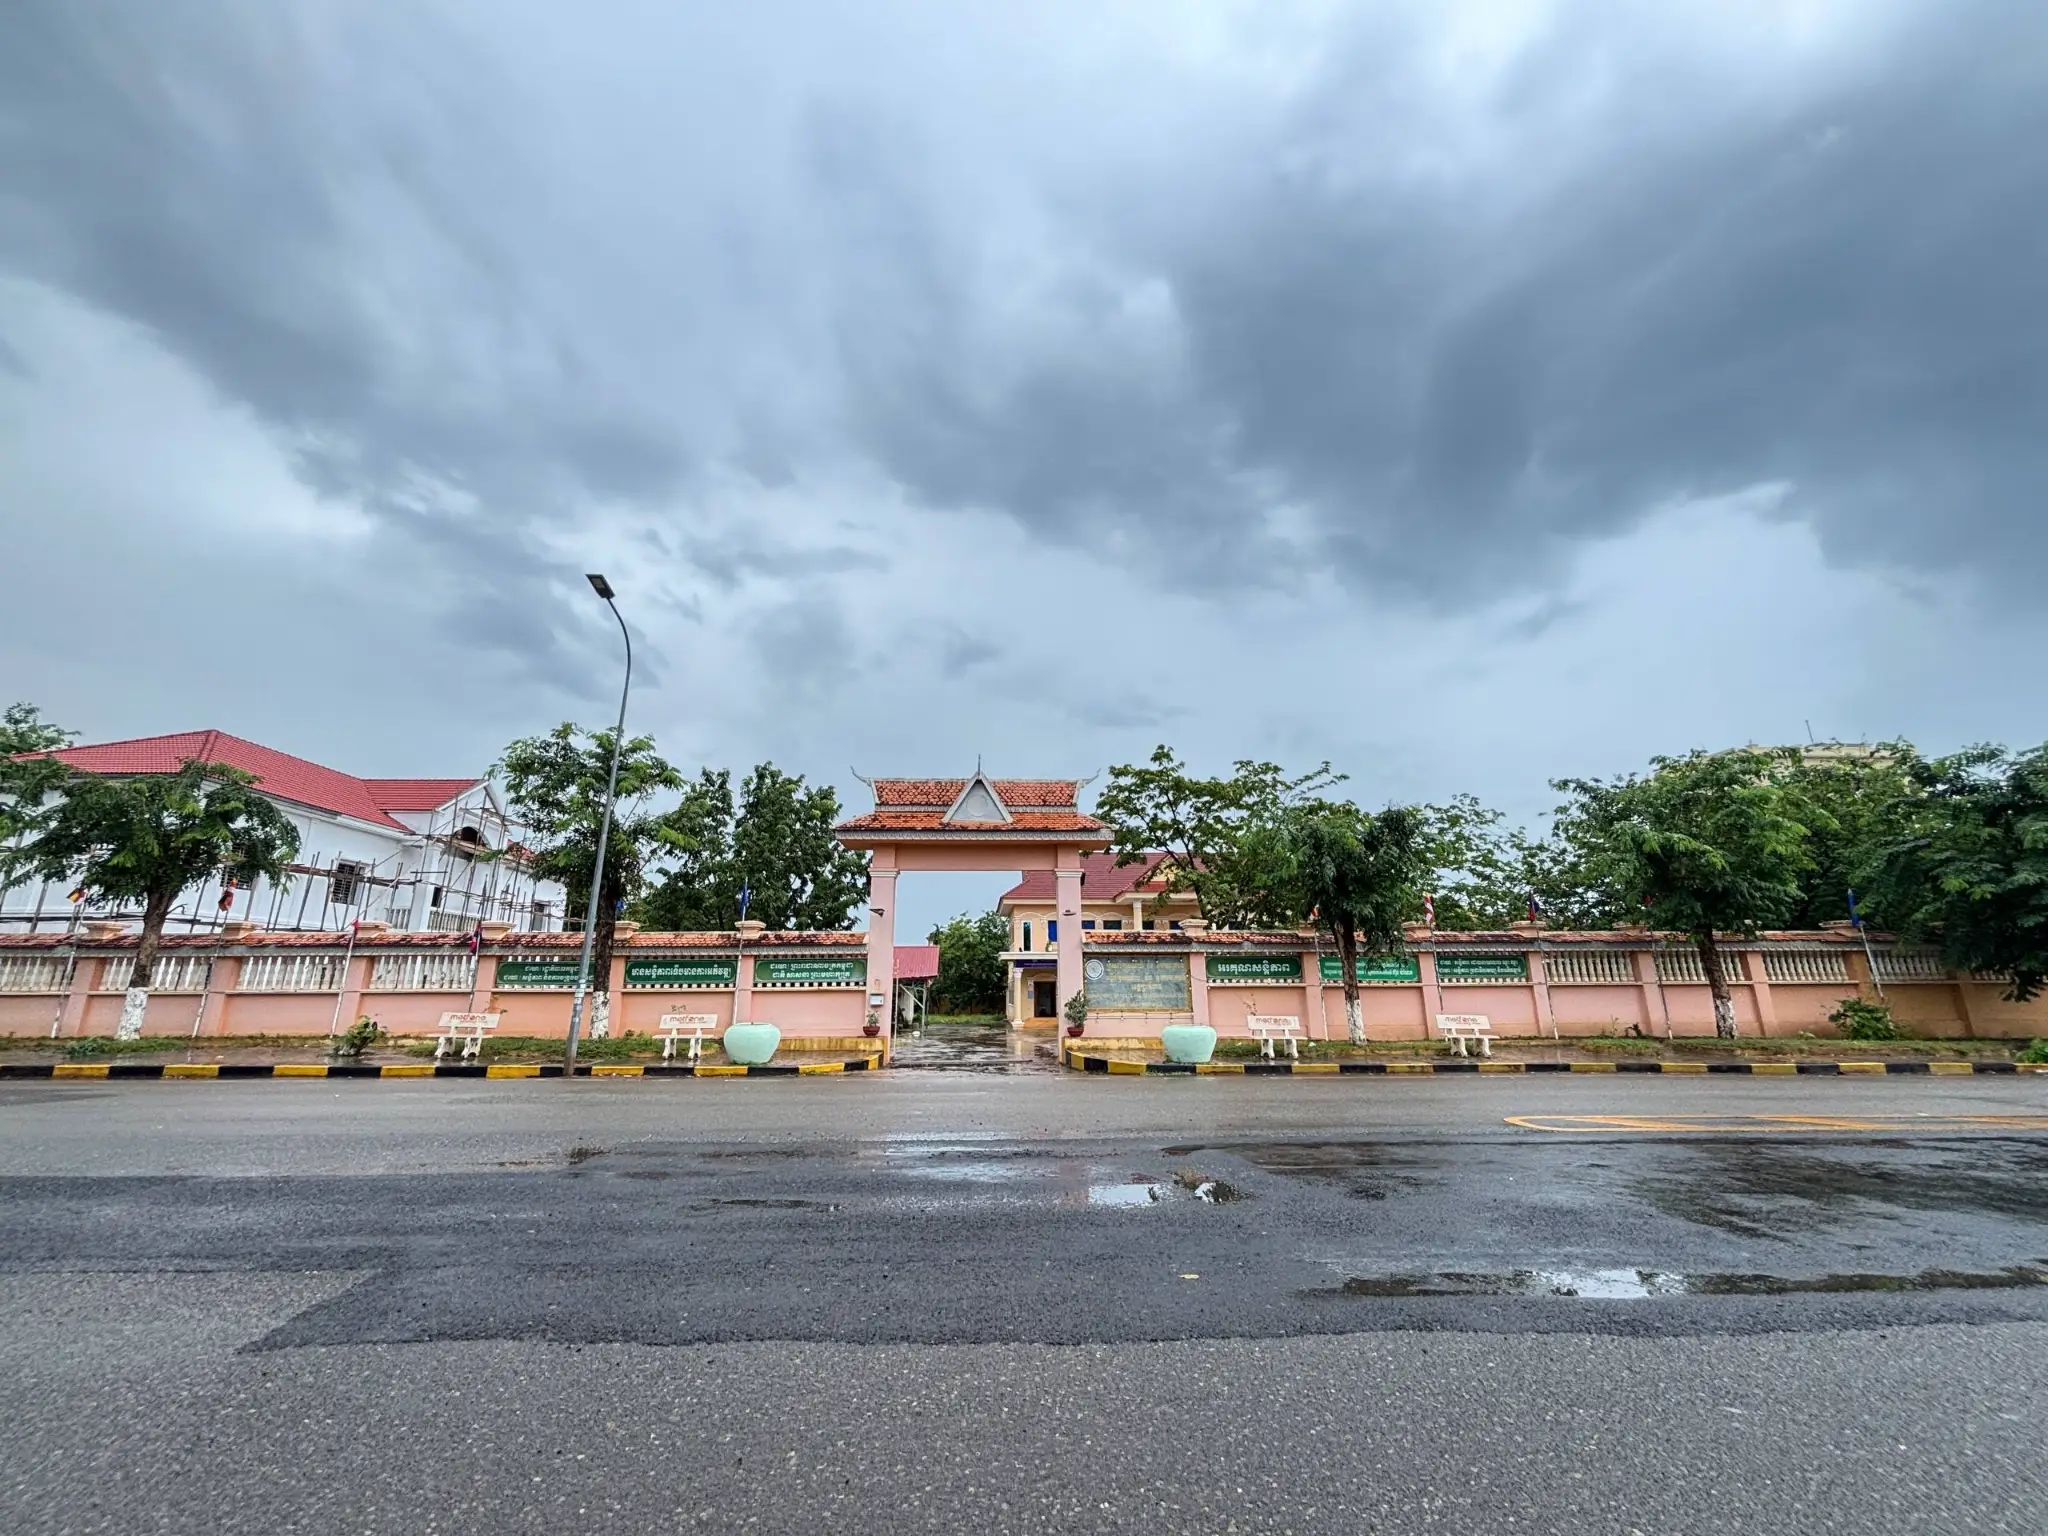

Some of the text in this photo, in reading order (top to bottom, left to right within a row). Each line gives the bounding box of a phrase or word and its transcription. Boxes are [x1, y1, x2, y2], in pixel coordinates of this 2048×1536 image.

[1217, 960, 1290, 975] អរគុណសន្តិភាព
